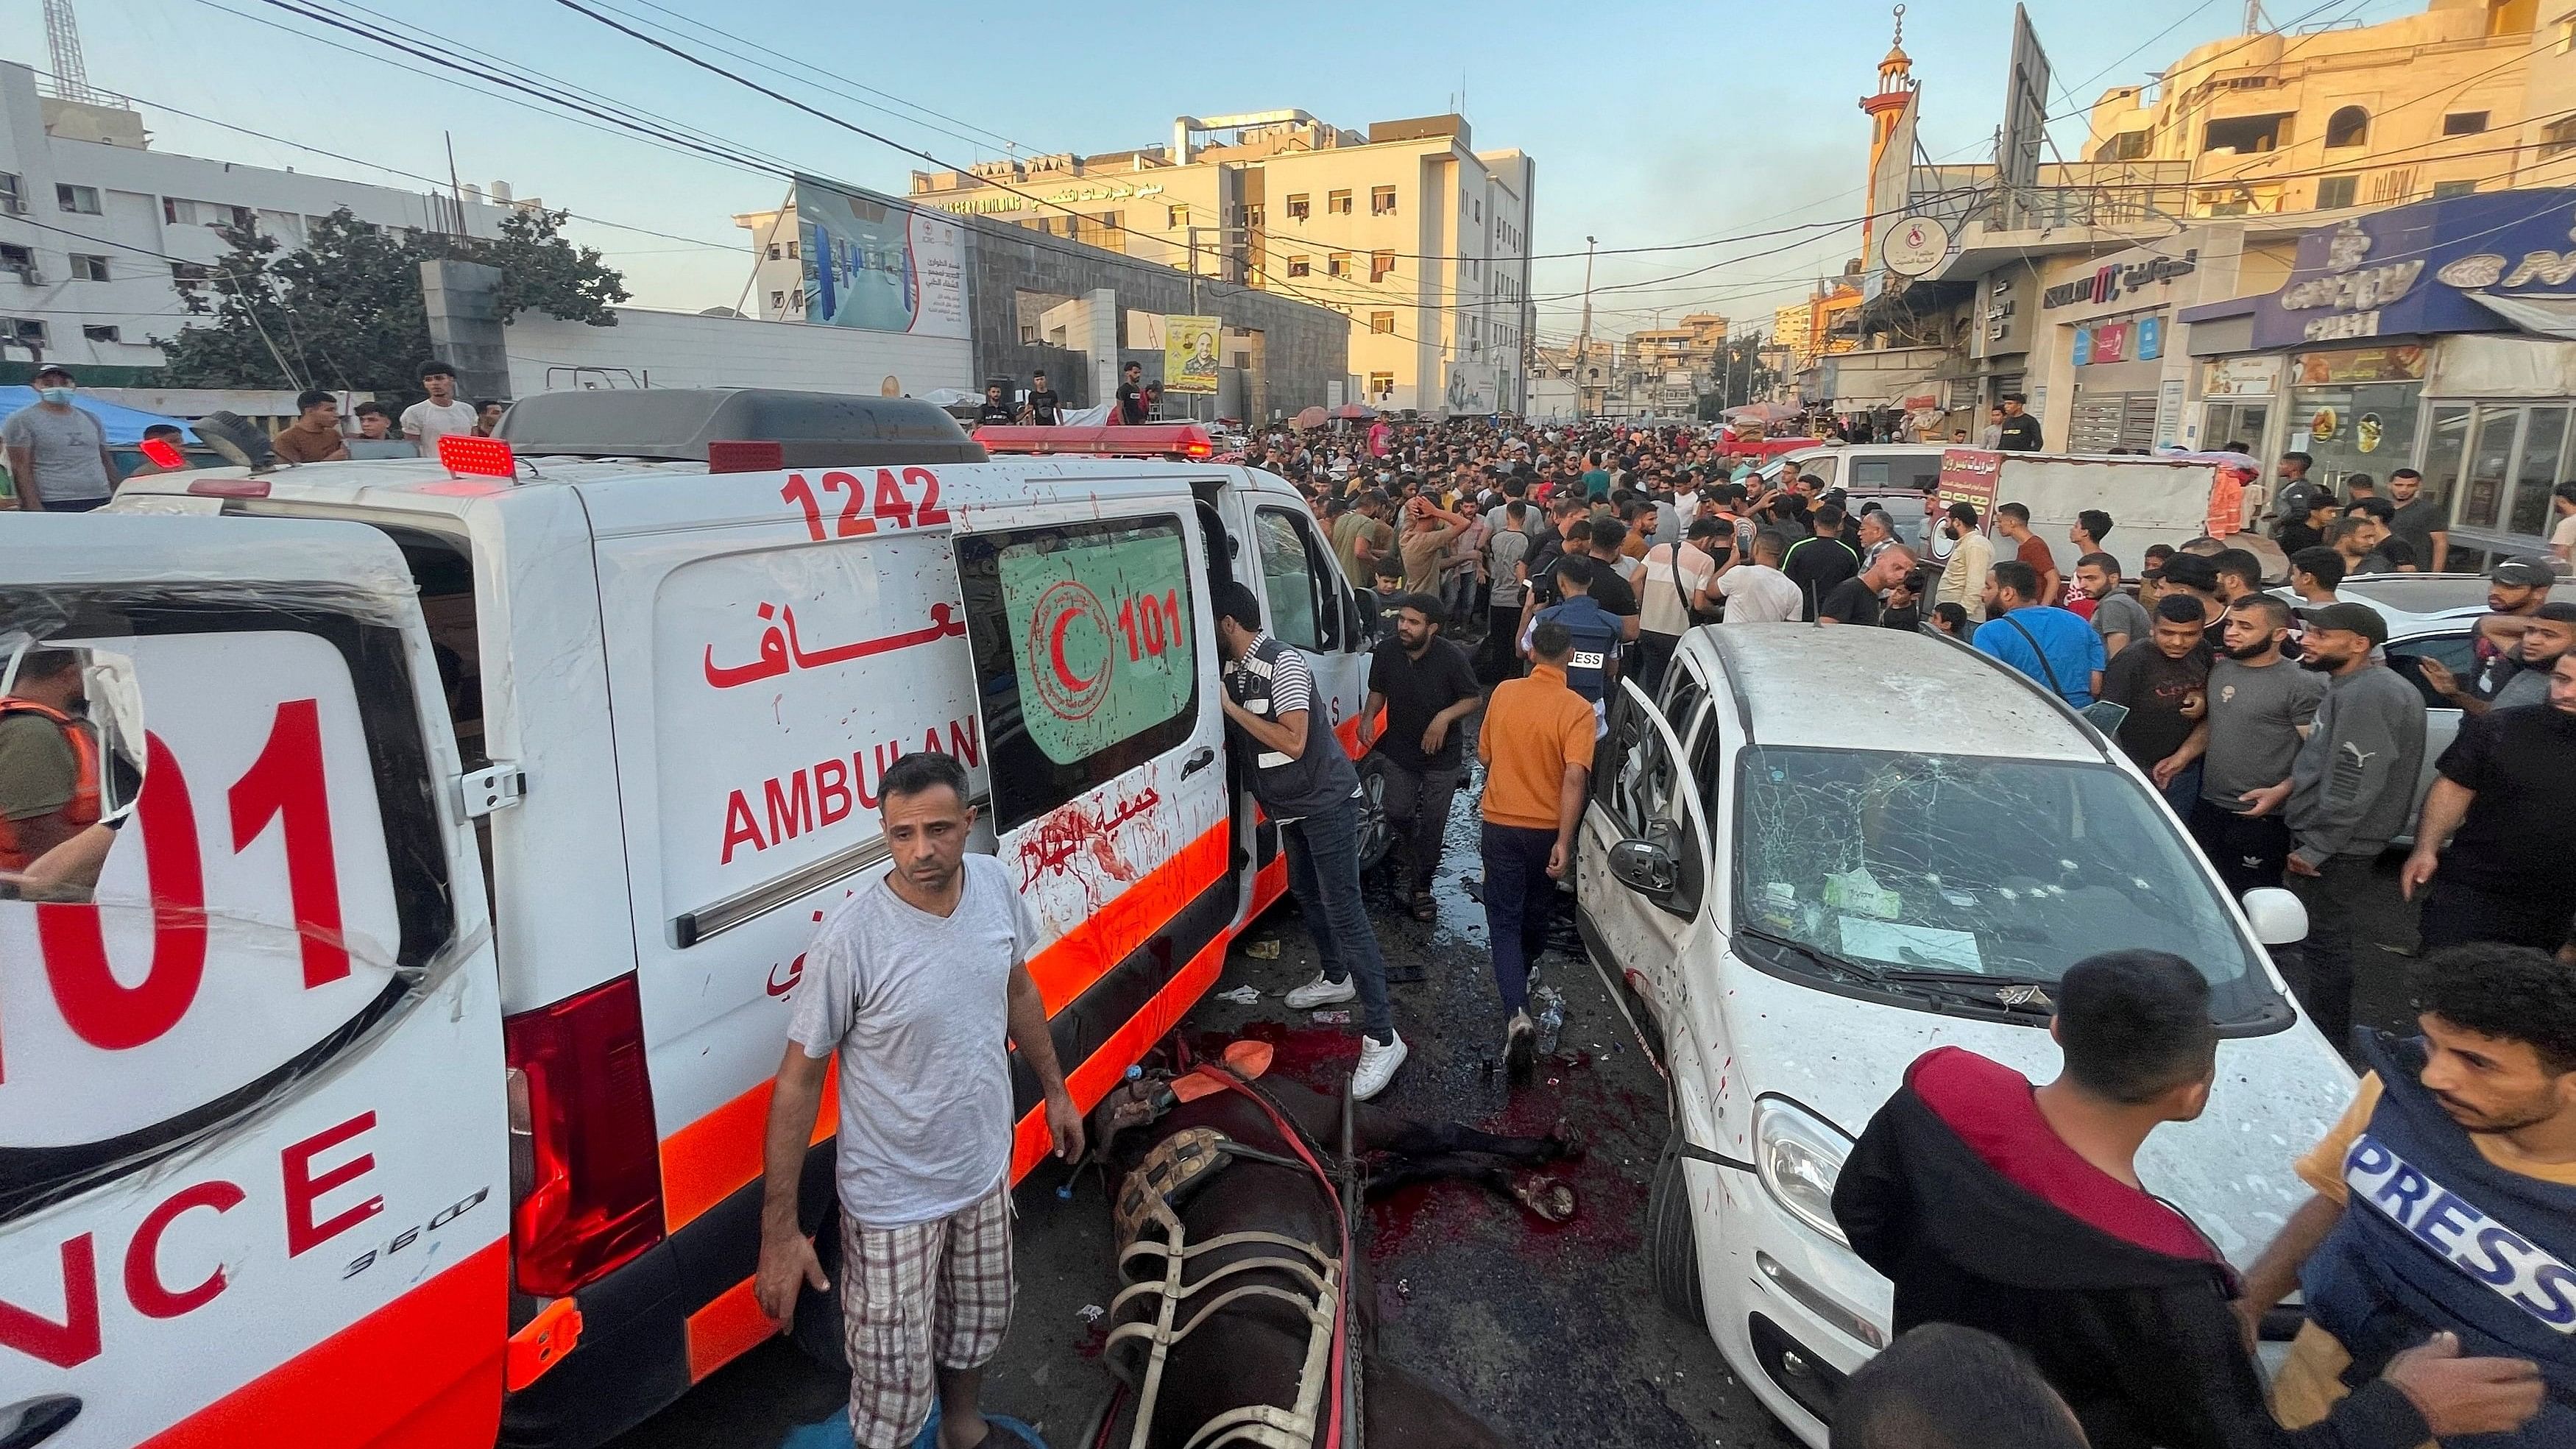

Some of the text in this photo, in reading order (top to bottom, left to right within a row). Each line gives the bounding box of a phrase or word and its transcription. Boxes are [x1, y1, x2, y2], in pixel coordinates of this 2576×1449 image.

[979, 196, 1022, 214] BUILDING
[779, 467, 951, 542] 1242
[704, 601, 967, 689] عاف
[1118, 588, 1184, 662] 101
[1575, 653, 1601, 665] ESS
[1093, 786, 1159, 843] جمعية
[0, 698, 352, 1049] 01
[2345, 1135, 2576, 1325] PRESS
